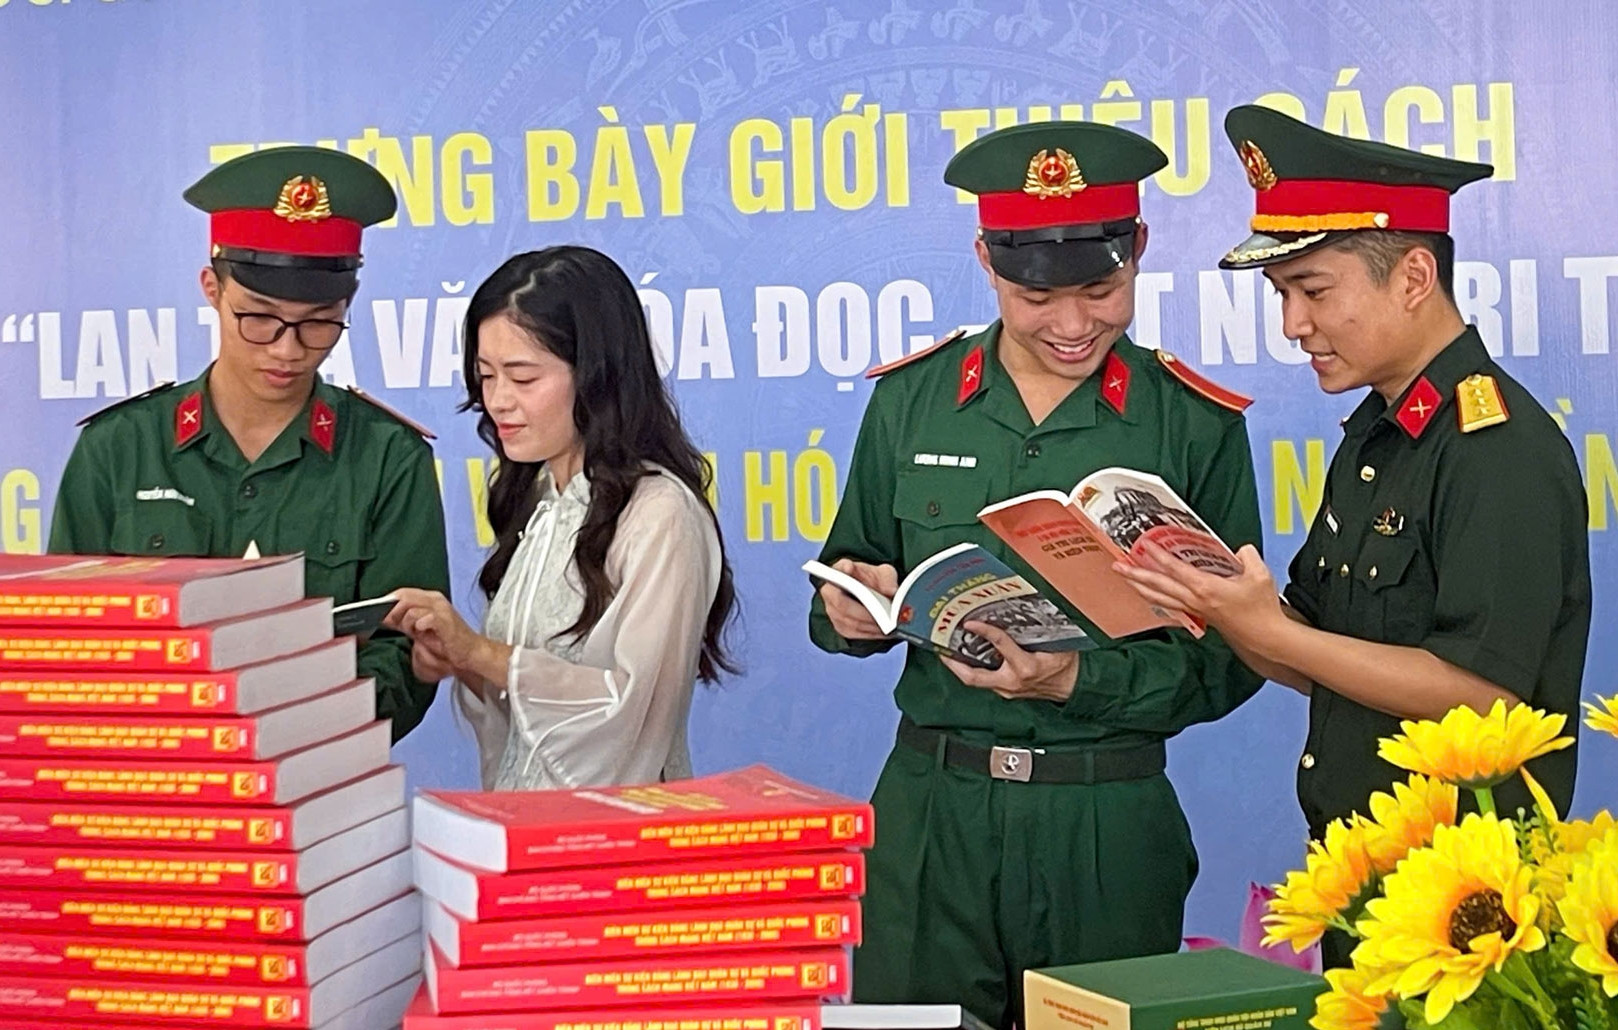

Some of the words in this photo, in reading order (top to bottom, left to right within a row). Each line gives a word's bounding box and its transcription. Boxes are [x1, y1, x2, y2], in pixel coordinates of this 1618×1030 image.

[525, 106, 697, 222] BÀY
[730, 94, 910, 214] GIỚI
[372, 281, 469, 389] VĂ
[752, 279, 934, 392] ĐỌC
[744, 429, 838, 542] HÓ
